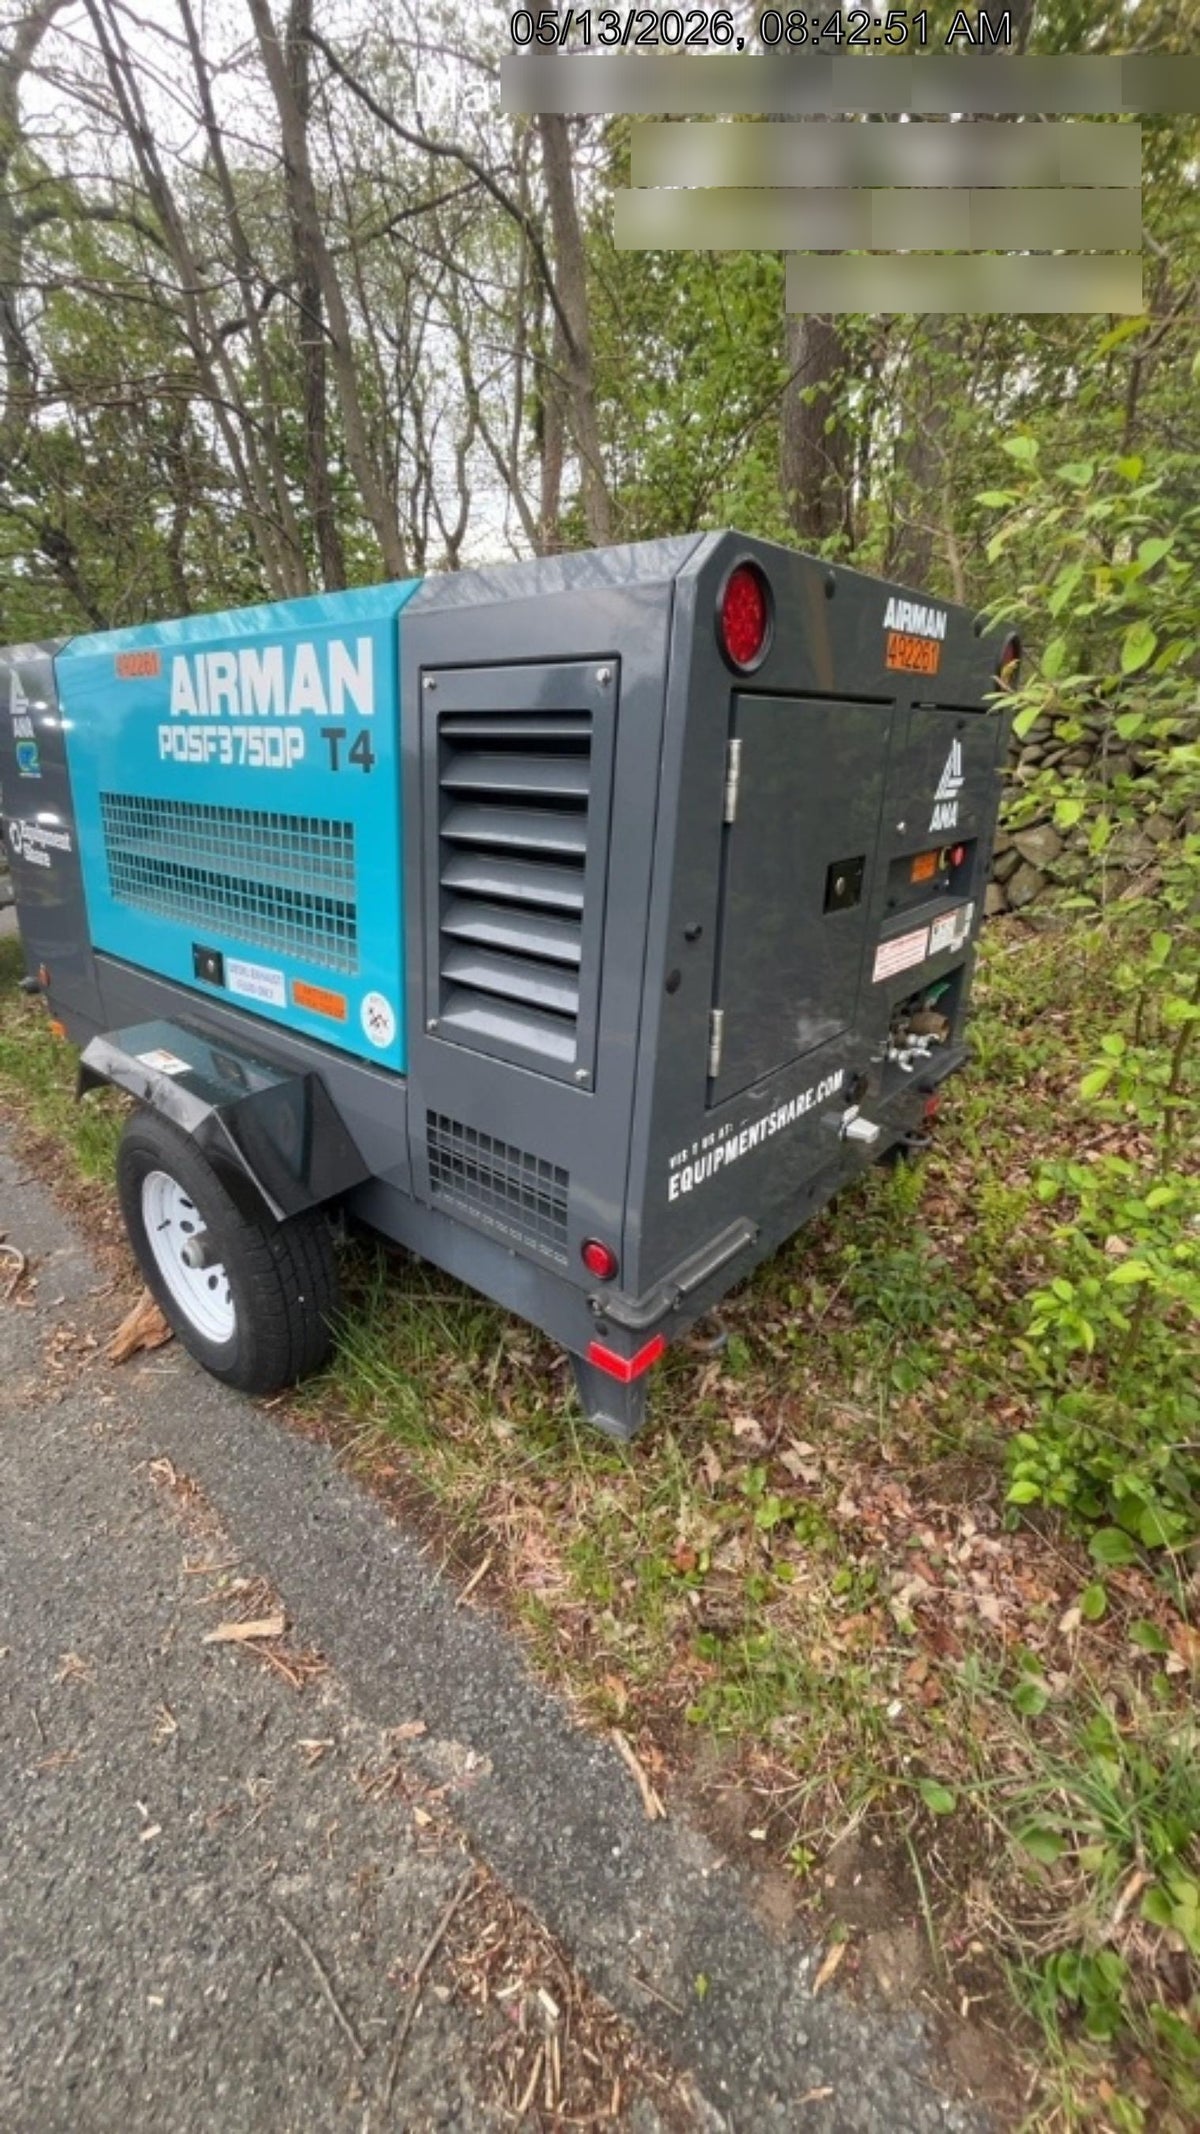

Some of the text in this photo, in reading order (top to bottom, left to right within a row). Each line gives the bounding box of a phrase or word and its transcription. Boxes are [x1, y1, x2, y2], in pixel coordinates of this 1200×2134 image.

[884, 598, 947, 640] AIRMAN
[170, 637, 374, 716] AIRMAN
[321, 727, 375, 773] T4
[929, 801, 959, 832] ANA
[668, 1069, 844, 1202] EQUIPMENTSHARE.COM
